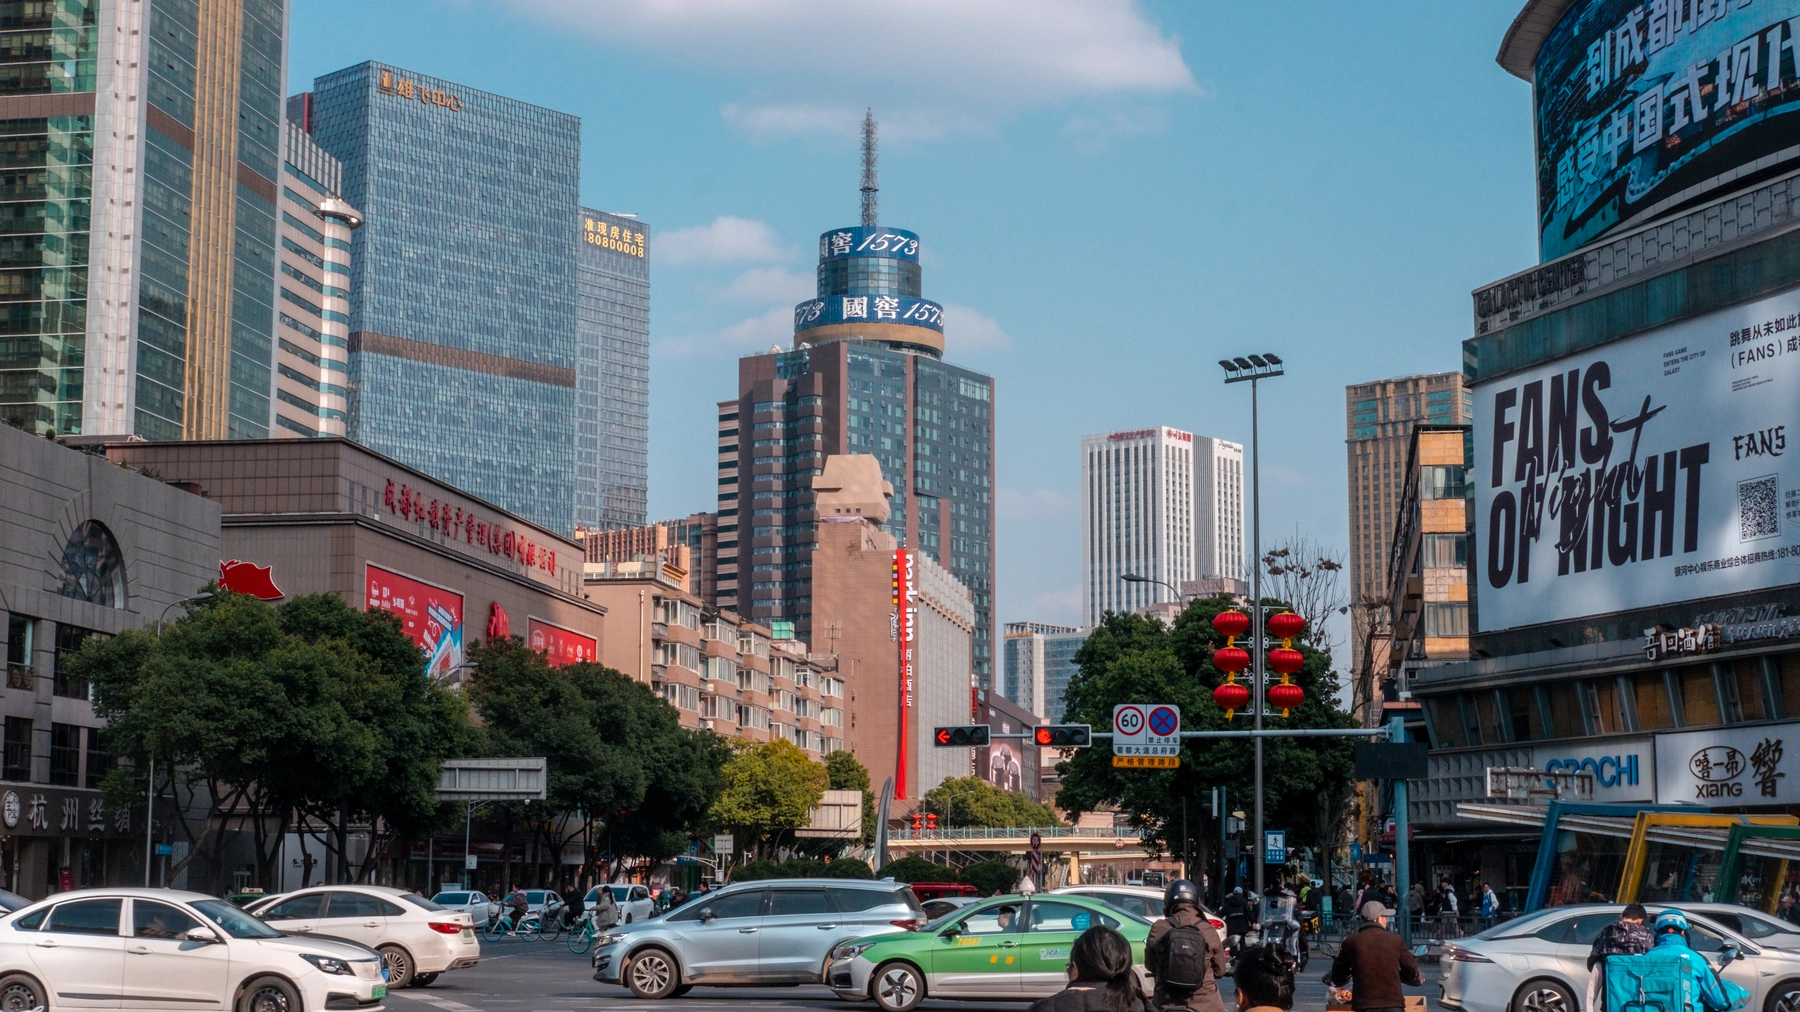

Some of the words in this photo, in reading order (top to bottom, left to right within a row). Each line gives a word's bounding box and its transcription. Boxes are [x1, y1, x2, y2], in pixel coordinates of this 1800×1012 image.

[397, 78, 462, 112] 雄飞中心
[584, 218, 645, 247] 准现房住宅
[587, 232, 645, 258] 80800008
[856, 233, 919, 255] 1573
[842, 296, 900, 320] 國窖
[1492, 362, 1611, 489] FANS
[1732, 425, 1786, 461] FANS
[1121, 713, 1139, 728] 60
[1116, 746, 1177, 755] 蜀都大道总府路
[1116, 757, 1177, 766] 严格管理路段
